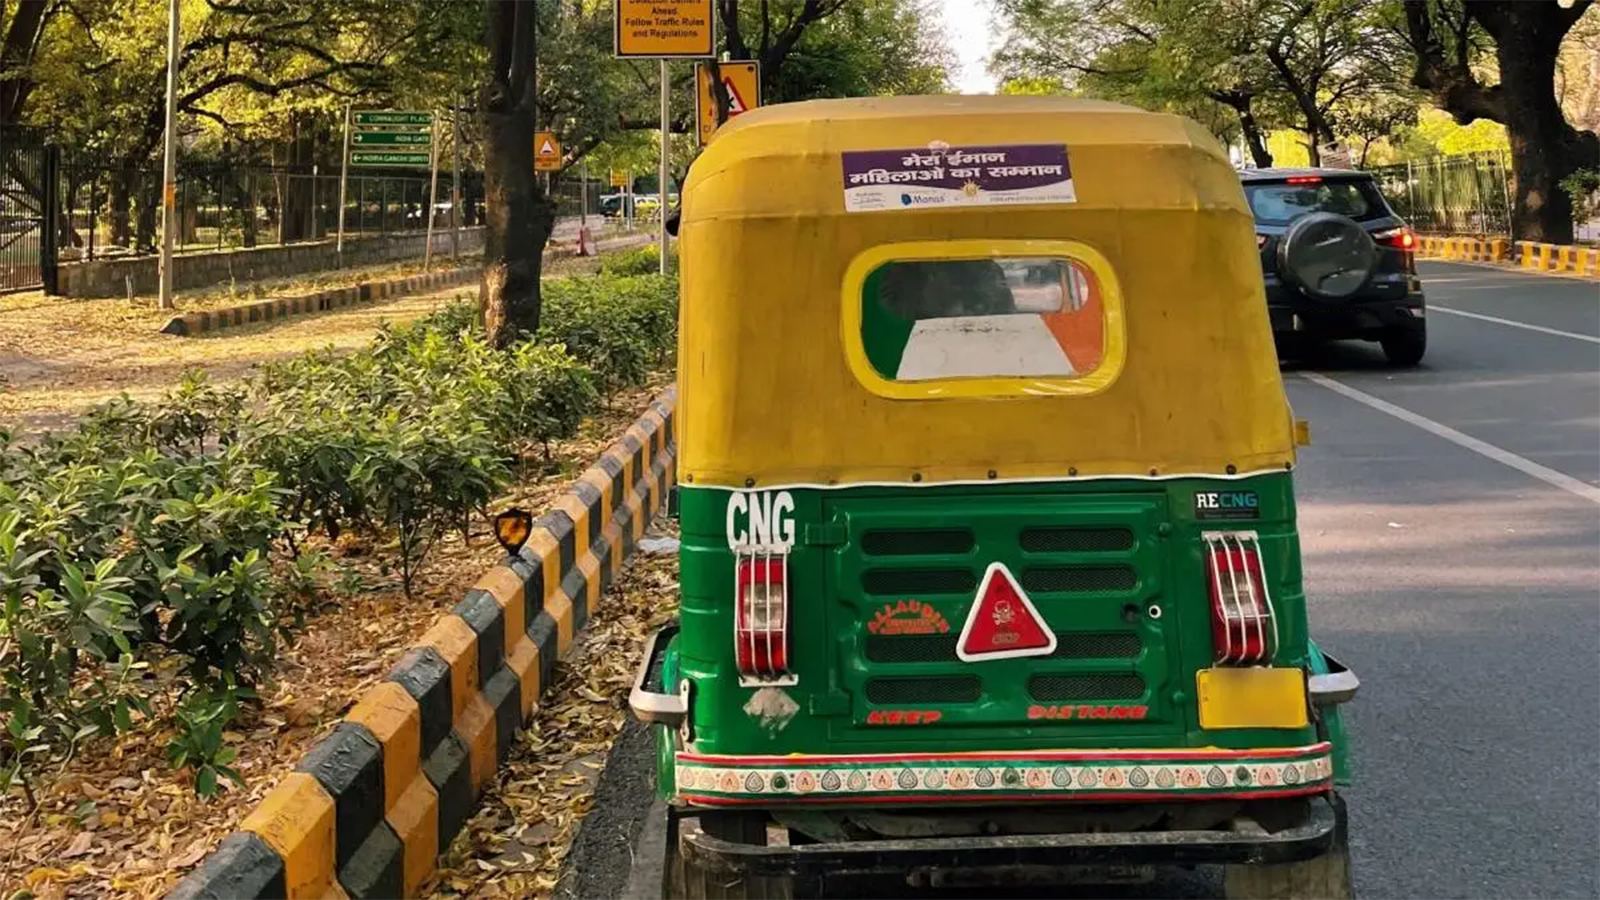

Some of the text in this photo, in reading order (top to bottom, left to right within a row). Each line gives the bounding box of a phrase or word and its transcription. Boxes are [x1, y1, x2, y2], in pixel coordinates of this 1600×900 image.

[652, 7, 678, 15] Ahead
[625, 18, 705, 26] Follow Traffic Rules
[650, 29, 699, 39] Regulations
[901, 150, 1006, 167] मेरा ईमान
[949, 167, 981, 178] का
[986, 164, 1063, 177] सम्मान
[726, 491, 796, 551] CNG
[866, 710, 942, 725] KEEP
